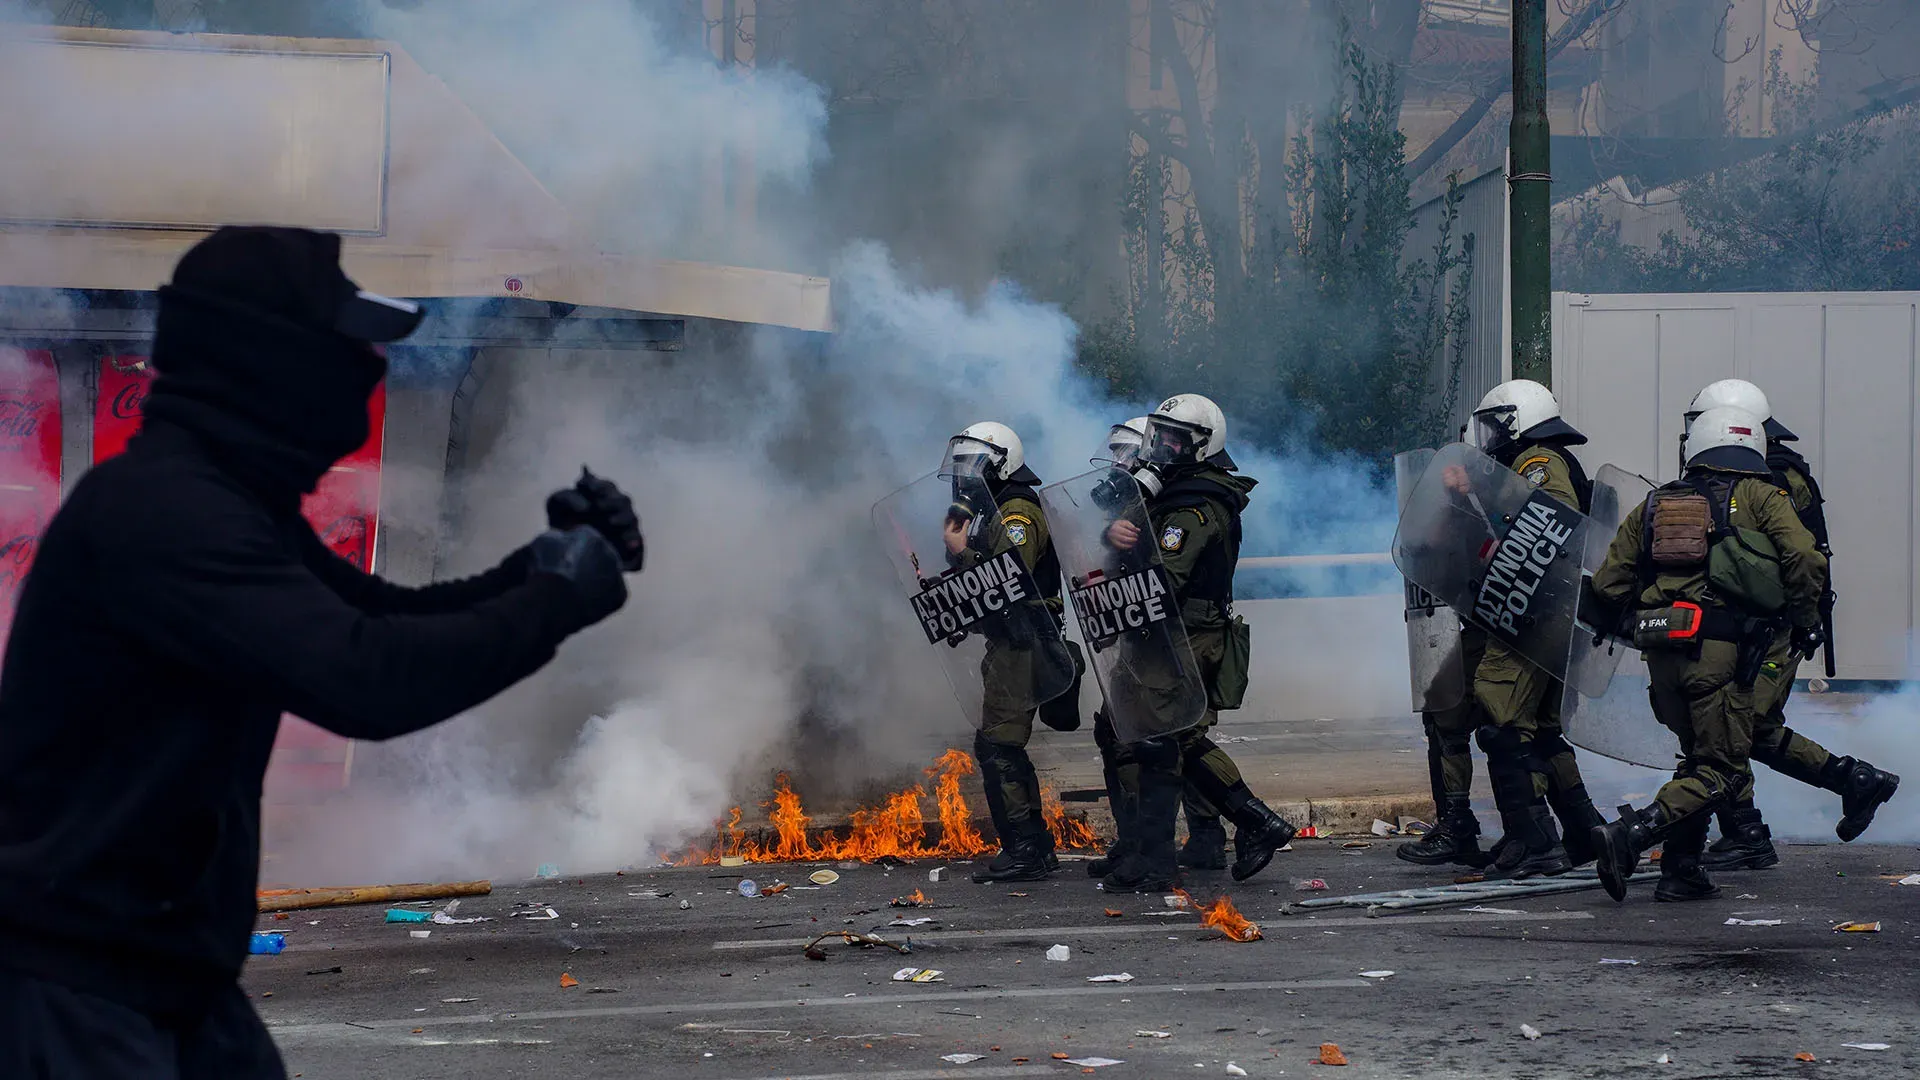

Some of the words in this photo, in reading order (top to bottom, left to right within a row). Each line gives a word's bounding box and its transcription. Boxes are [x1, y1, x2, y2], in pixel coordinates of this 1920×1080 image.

[914, 552, 1023, 622] ΑΣΤΥΝΟΜΙΑ
[1474, 501, 1557, 629] ΑΣΤΥΝΟΜΙΑ
[1500, 518, 1573, 636] POLICE
[927, 577, 1026, 640] POLICE
[1648, 618, 1668, 628] IFAK
